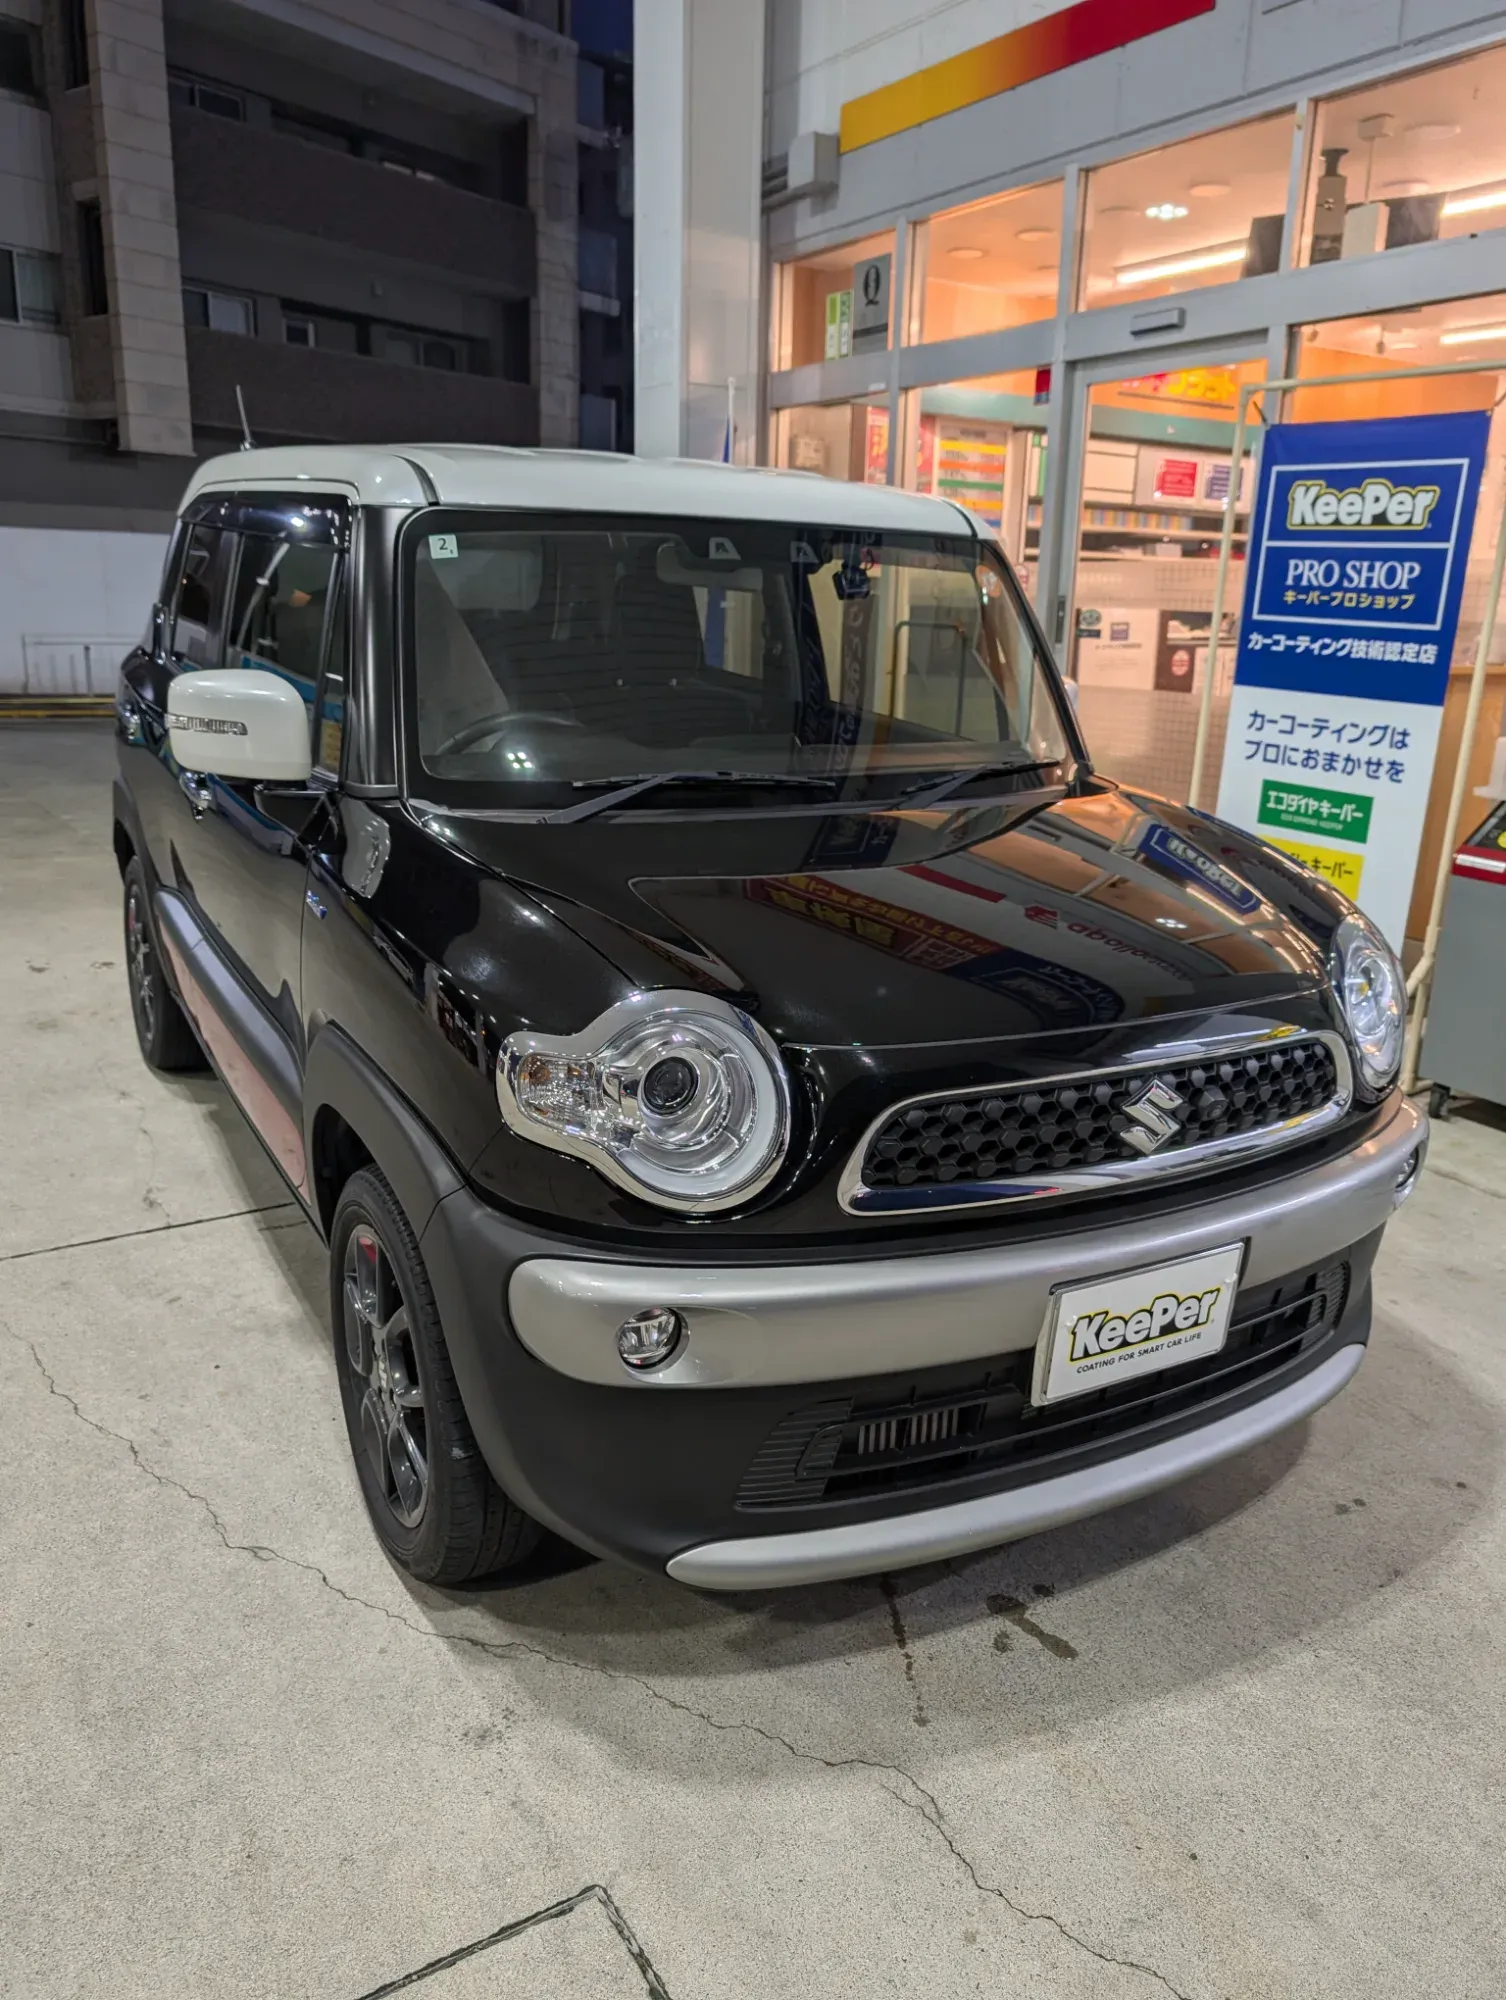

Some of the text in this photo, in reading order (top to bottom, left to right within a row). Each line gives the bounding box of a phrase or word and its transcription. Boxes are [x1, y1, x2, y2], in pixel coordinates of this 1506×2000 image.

[1288, 480, 1439, 529] KeePer
[1285, 559, 1421, 589] PRO SHOP
[1284, 589, 1416, 611] キーパープロショップ
[1247, 631, 1439, 665] カーコーティング技術認定店
[1247, 710, 1411, 750] カーコーティングは
[1245, 740, 1405, 783] プロにおまかせを
[1266, 790, 1364, 822] エコダイヤキーパー
[1069, 1287, 1221, 1362] KeePer
[1076, 1331, 1202, 1374] COATING FOR SMART CAR LIFE
